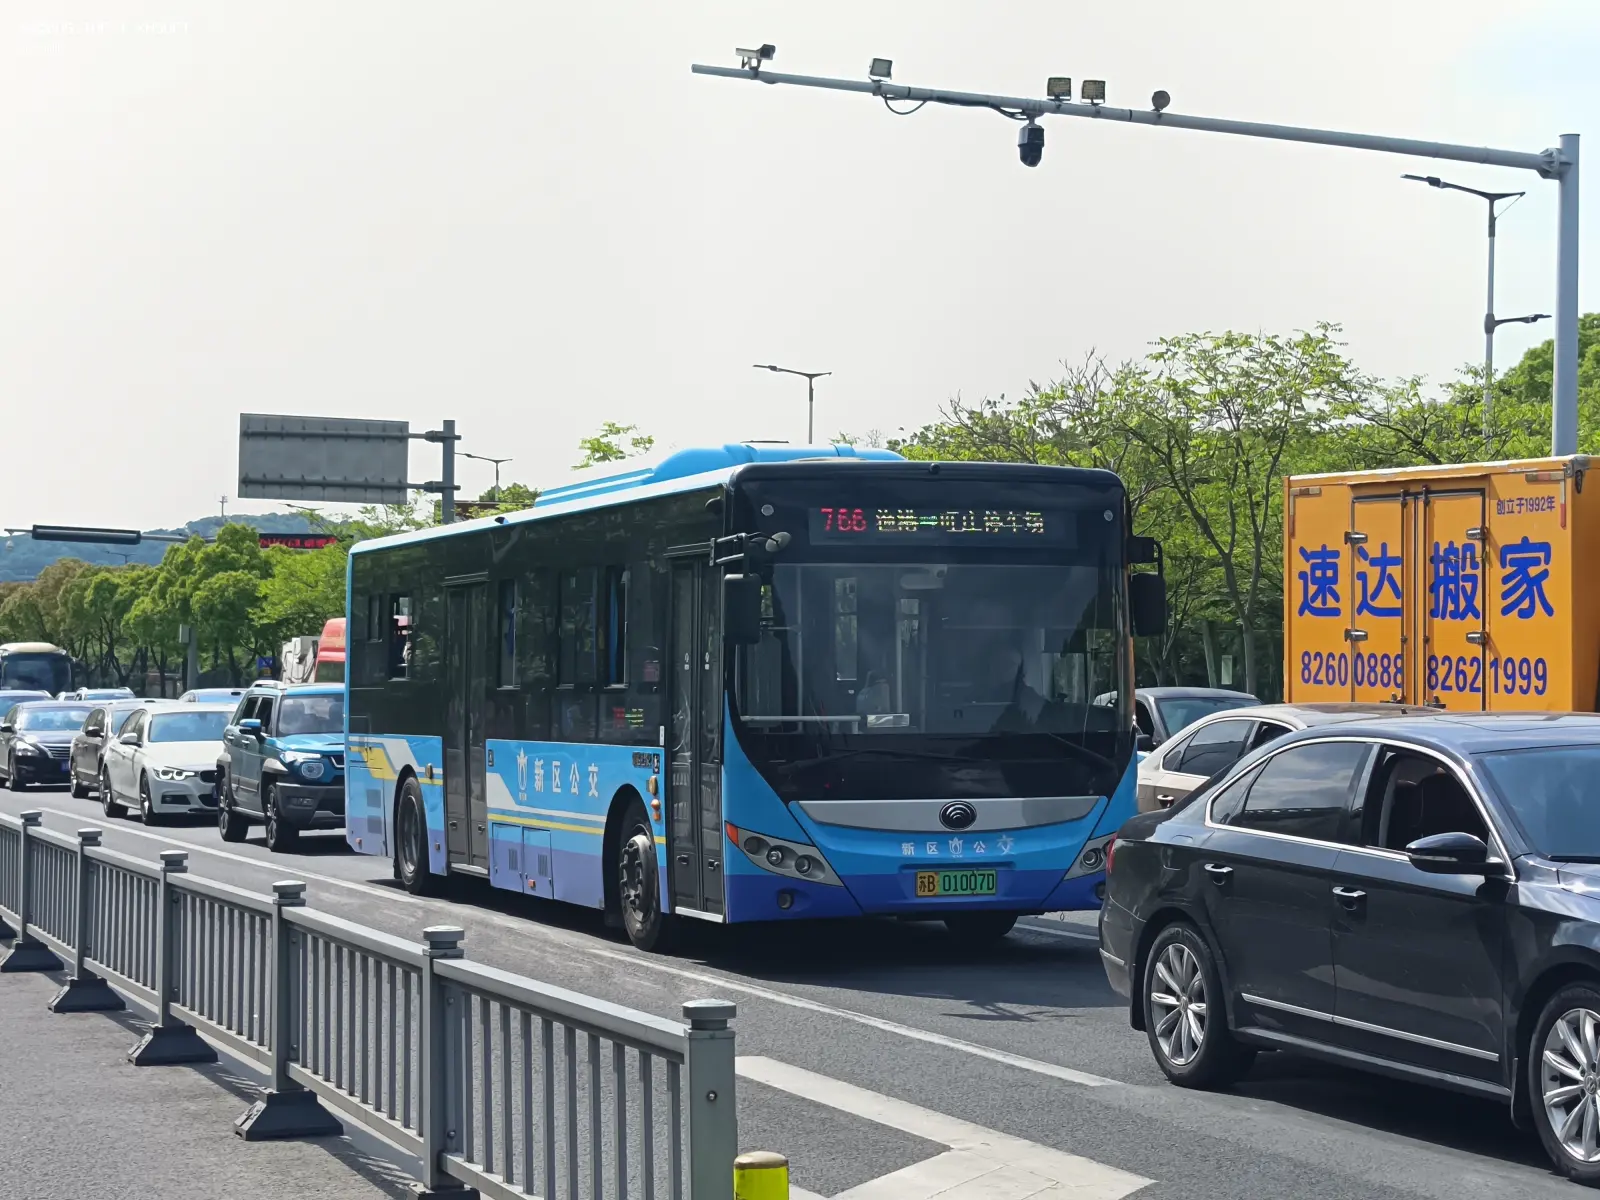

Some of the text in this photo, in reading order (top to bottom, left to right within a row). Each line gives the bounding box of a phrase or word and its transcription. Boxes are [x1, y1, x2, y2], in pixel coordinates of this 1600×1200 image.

[1496, 495, 1556, 515] 创立于1992年
[821, 508, 867, 532] 766
[1298, 536, 1554, 621] 速达搬家
